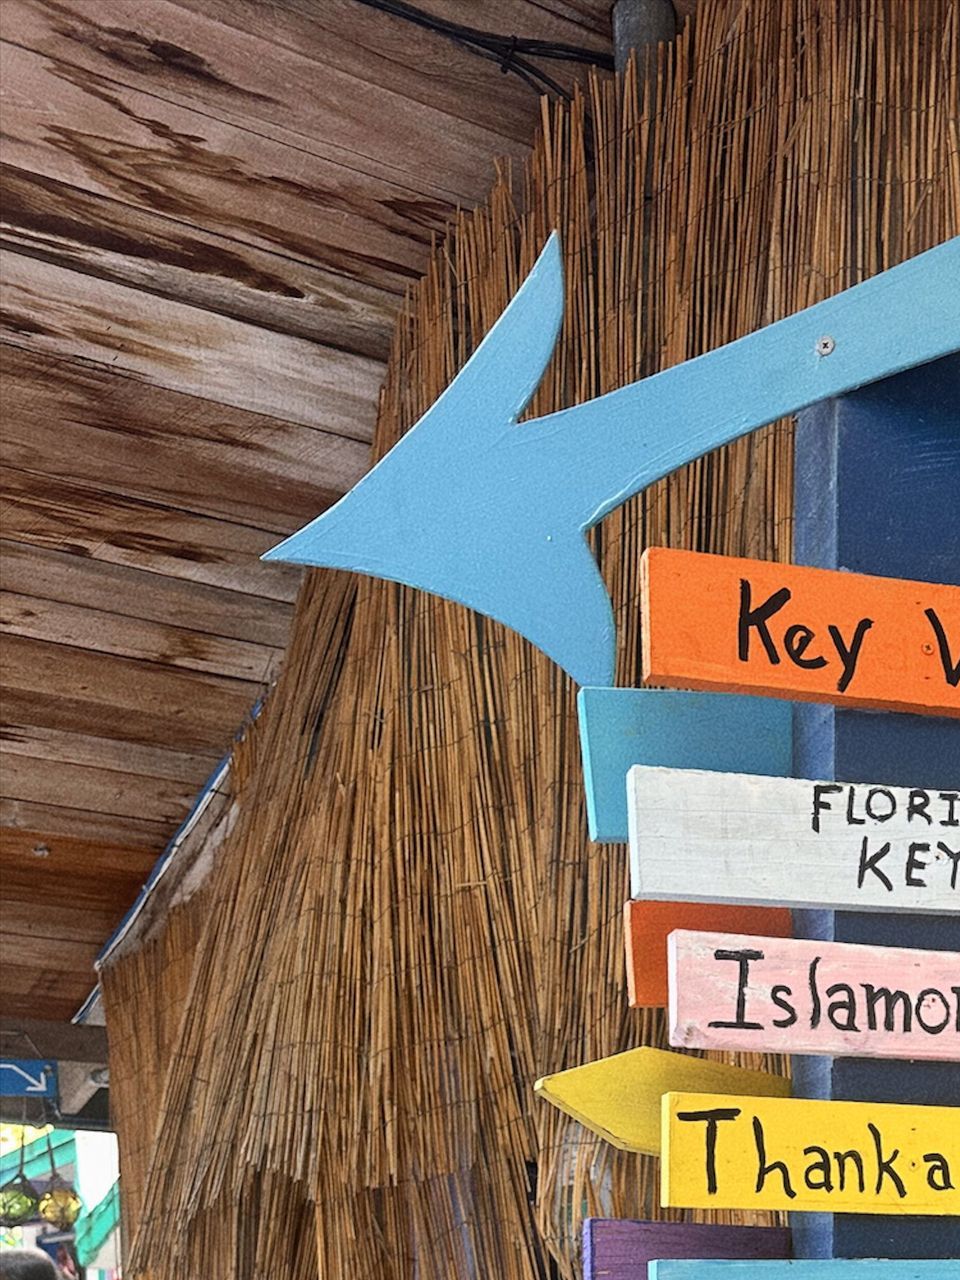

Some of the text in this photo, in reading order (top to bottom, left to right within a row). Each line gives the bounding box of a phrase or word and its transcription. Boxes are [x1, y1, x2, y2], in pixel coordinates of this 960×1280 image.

[737, 578, 874, 692] Key
[677, 1107, 908, 1199] Thank
[924, 1151, 956, 1191] a
